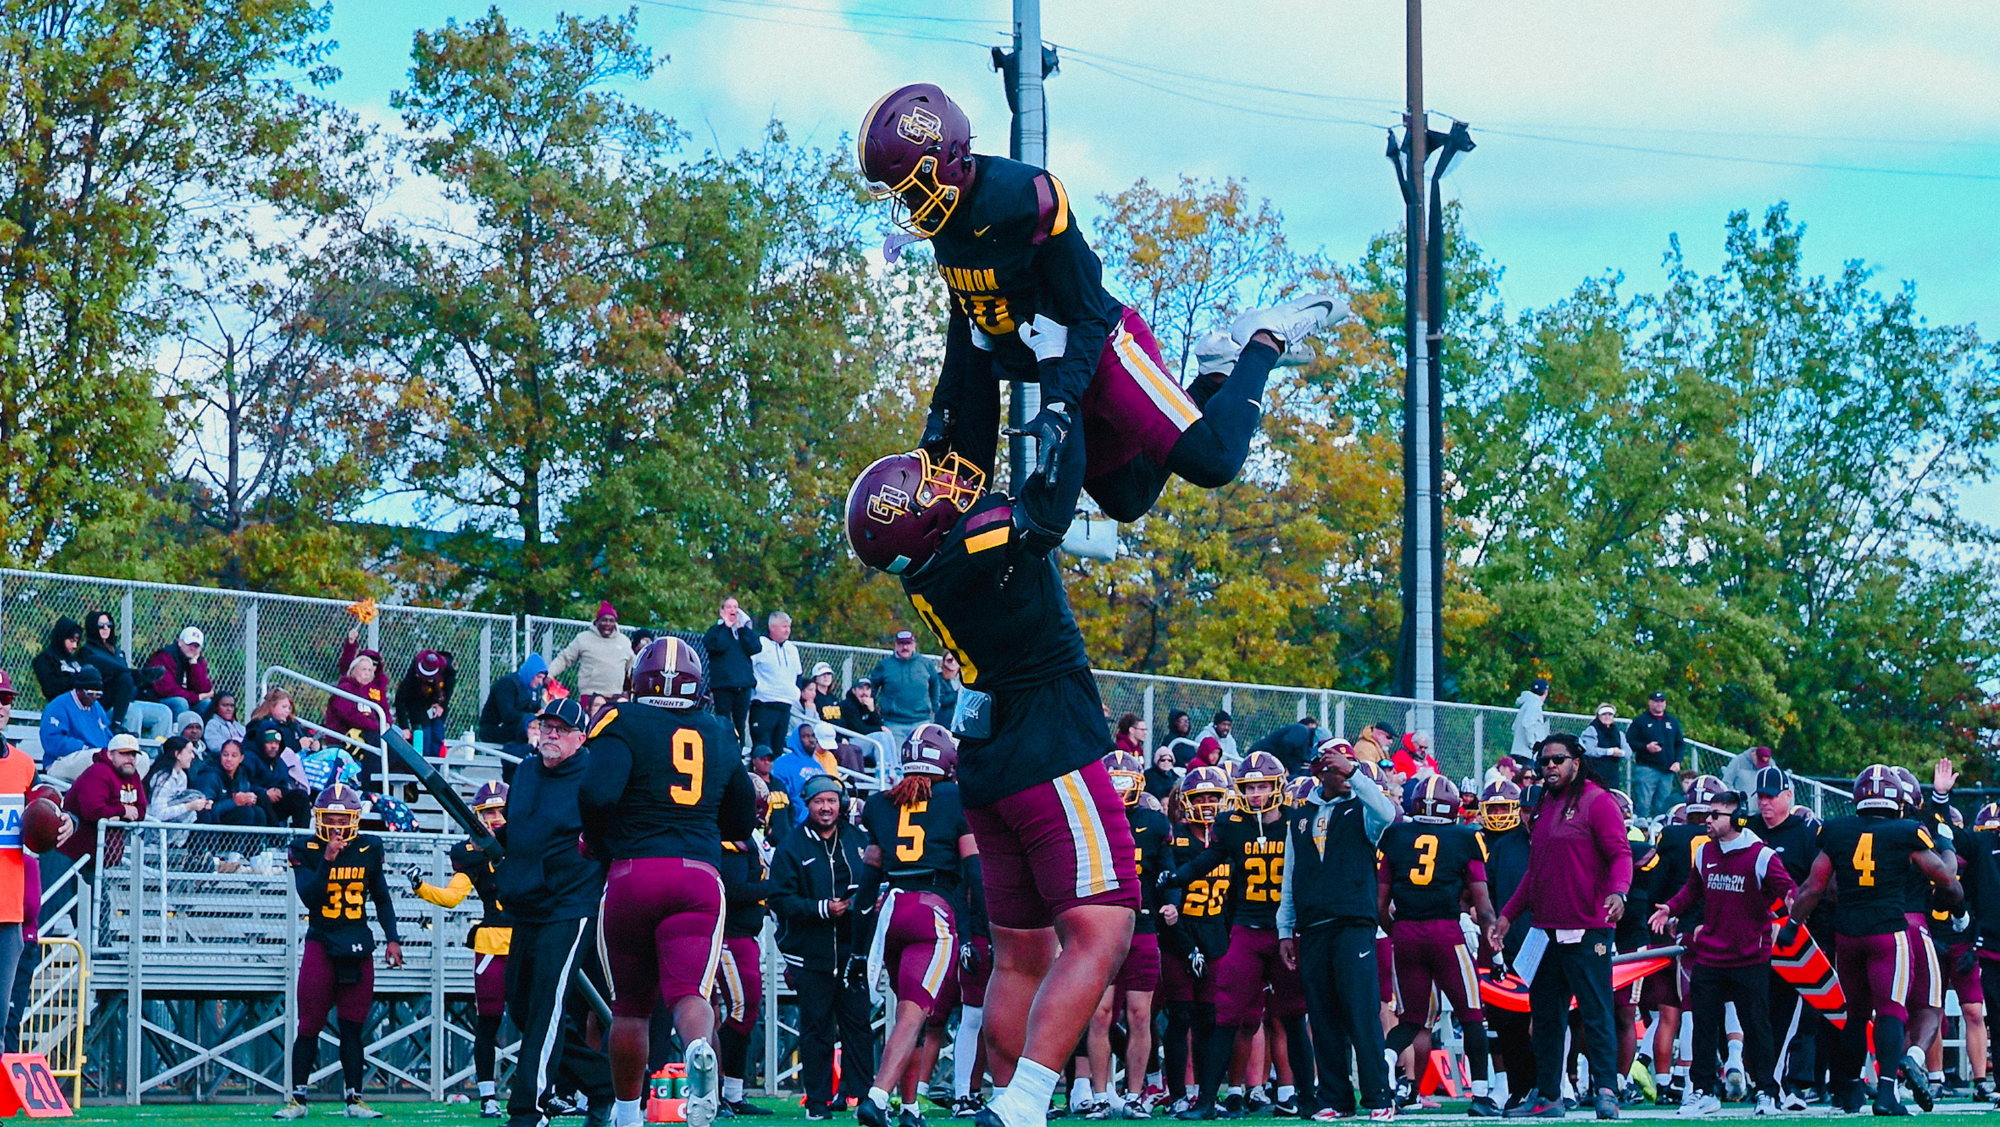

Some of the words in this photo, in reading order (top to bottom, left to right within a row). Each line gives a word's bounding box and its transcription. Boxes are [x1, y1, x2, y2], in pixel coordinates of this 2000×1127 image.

[940, 264, 999, 292] GANNON
[649, 699, 684, 707] KNIGHTS
[670, 728, 703, 806] 9
[896, 800, 928, 862] 5
[1245, 841, 1284, 855] GANNO
[1409, 834, 1438, 885] 3
[1852, 833, 1875, 886] 4
[328, 867, 366, 880] ANNON
[1244, 857, 1284, 902] 29
[1707, 882, 1745, 892] FOOTBALL
[1708, 873, 1745, 884] GANNON
[321, 881, 364, 919] 39
[1182, 880, 1230, 917] 20
[12, 1063, 62, 1109] 20
[657, 1085, 668, 1097] G
[680, 1085, 690, 1097] G
